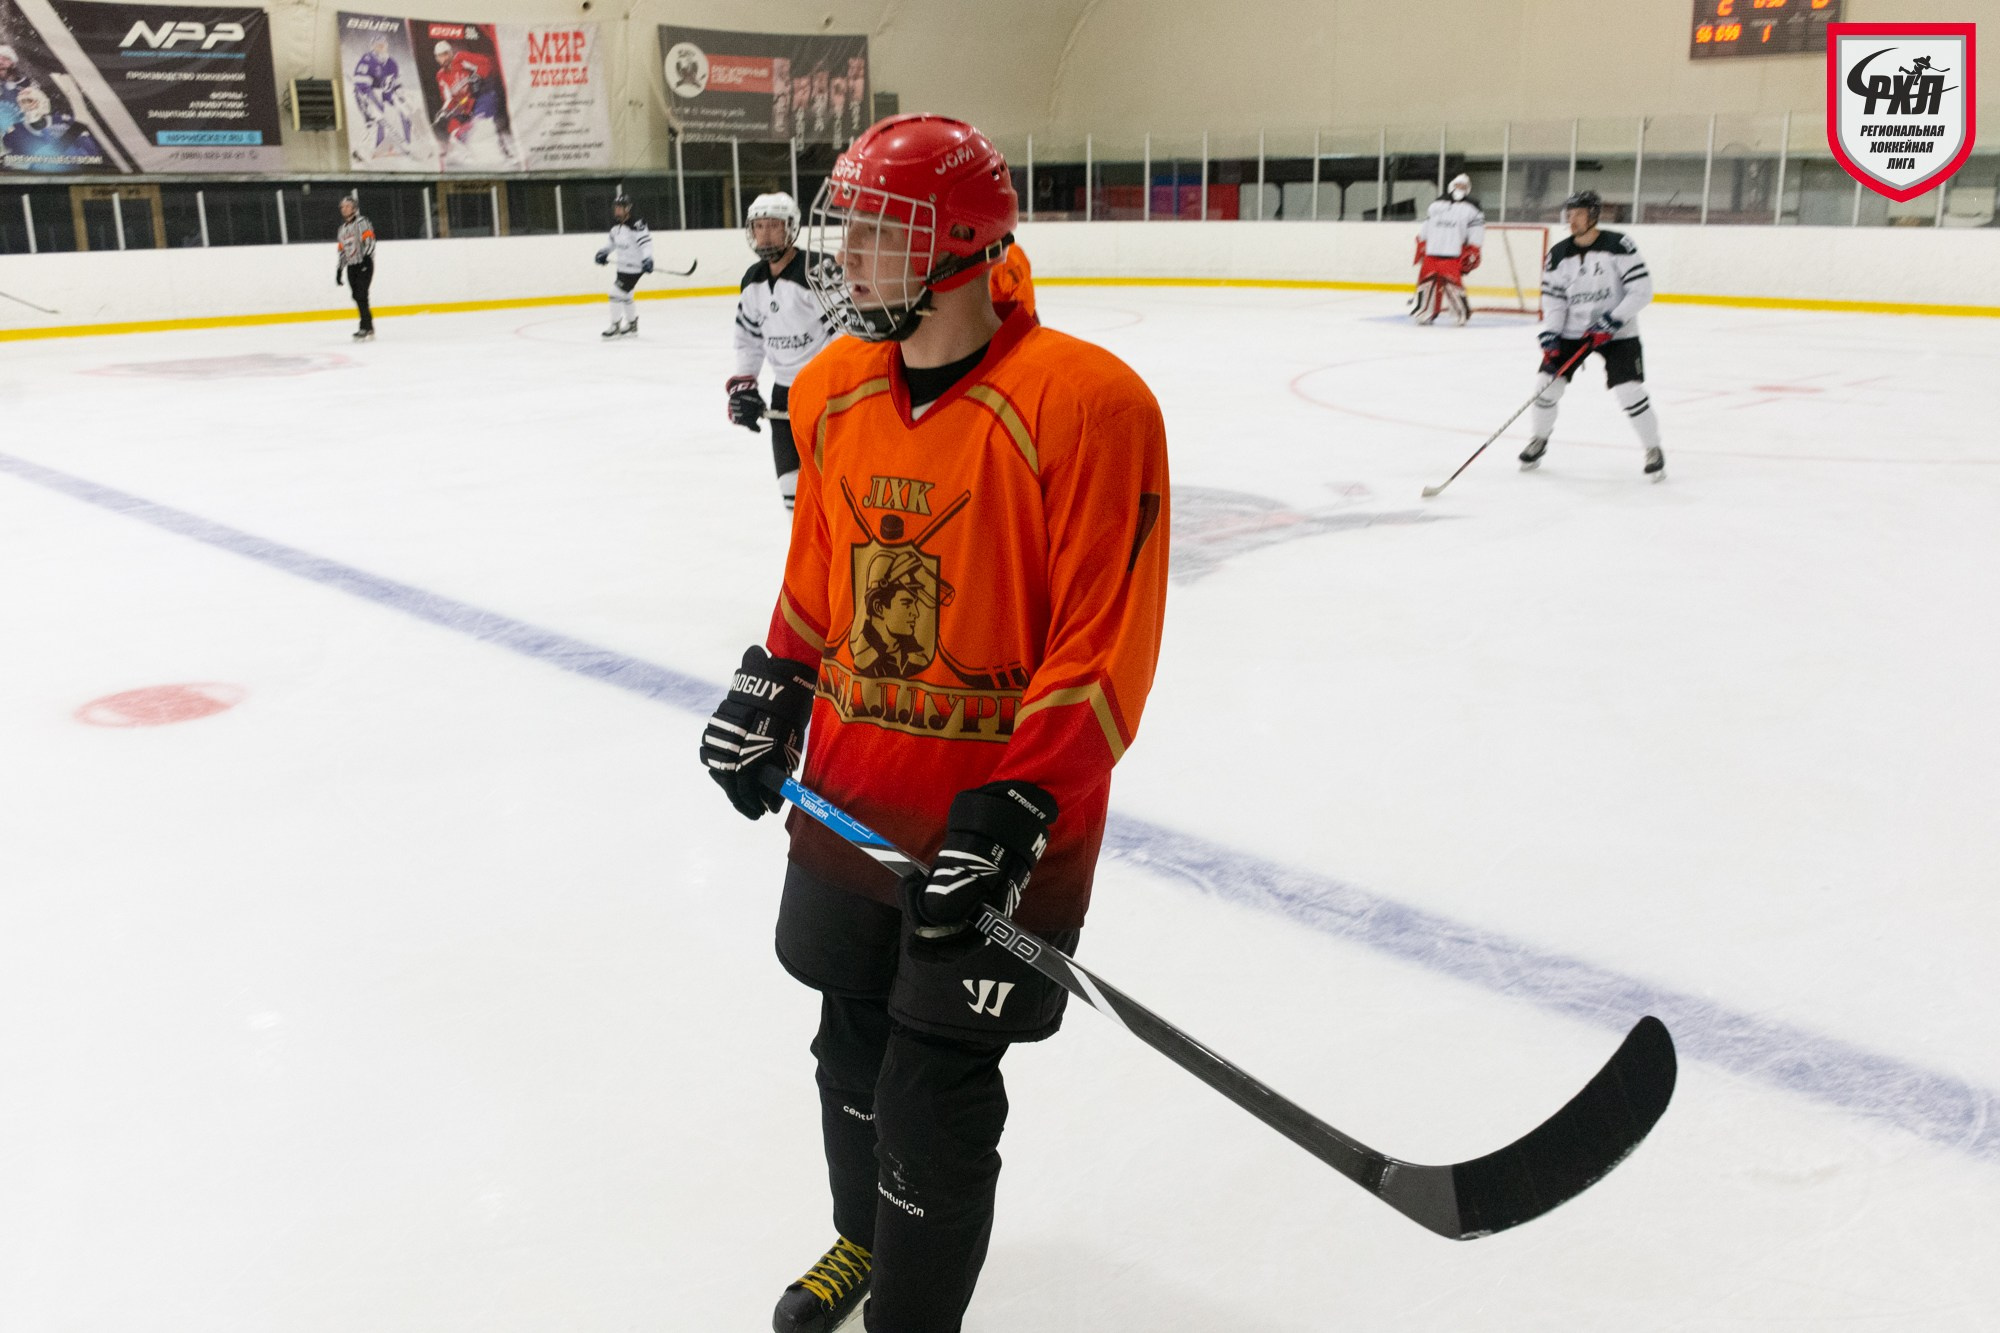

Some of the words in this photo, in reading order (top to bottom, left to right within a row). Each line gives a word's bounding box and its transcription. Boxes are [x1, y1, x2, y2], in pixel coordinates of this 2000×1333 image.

[118, 20, 245, 50] NPP
[528, 31, 586, 64] МИР
[530, 67, 588, 87] ХОККЕЯ
[863, 475, 935, 516] ЛХК
[815, 664, 1022, 735] АЛЛУРГ
[1007, 788, 1040, 815] STRIKE
